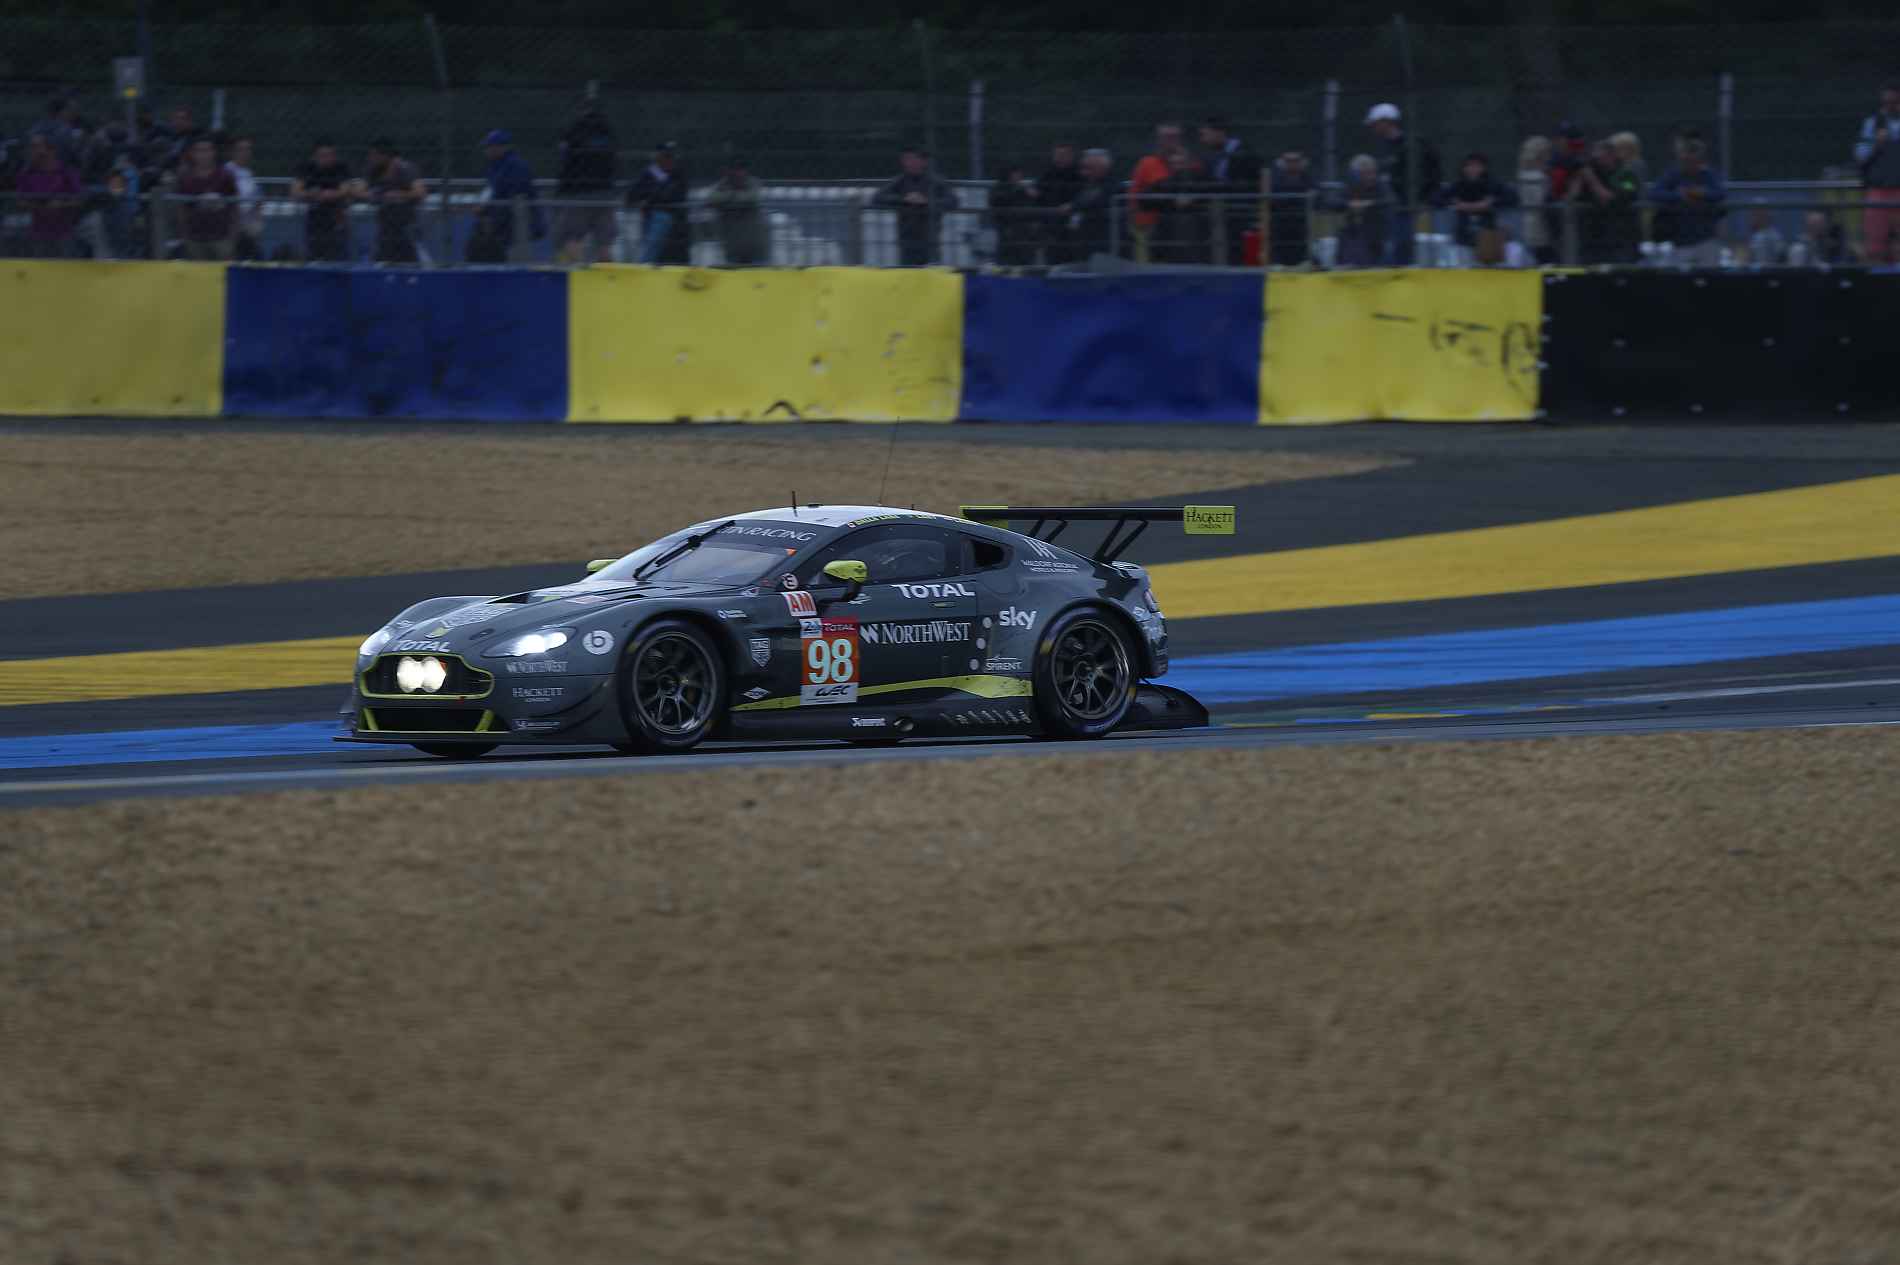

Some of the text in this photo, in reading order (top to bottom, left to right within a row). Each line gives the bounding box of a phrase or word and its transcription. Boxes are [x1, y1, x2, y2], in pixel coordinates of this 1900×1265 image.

[1186, 507, 1233, 522] HACKETT
[746, 527, 817, 541] RACING
[890, 583, 976, 599] TOTAL
[788, 592, 817, 613] AM
[999, 606, 1037, 630] sky
[822, 623, 856, 632] TOTAL
[881, 621, 971, 644] NORTHWEST
[392, 640, 451, 653] TOTAL
[807, 638, 854, 684] 98
[511, 687, 565, 698] HACKETT
[815, 685, 850, 697] WEC
